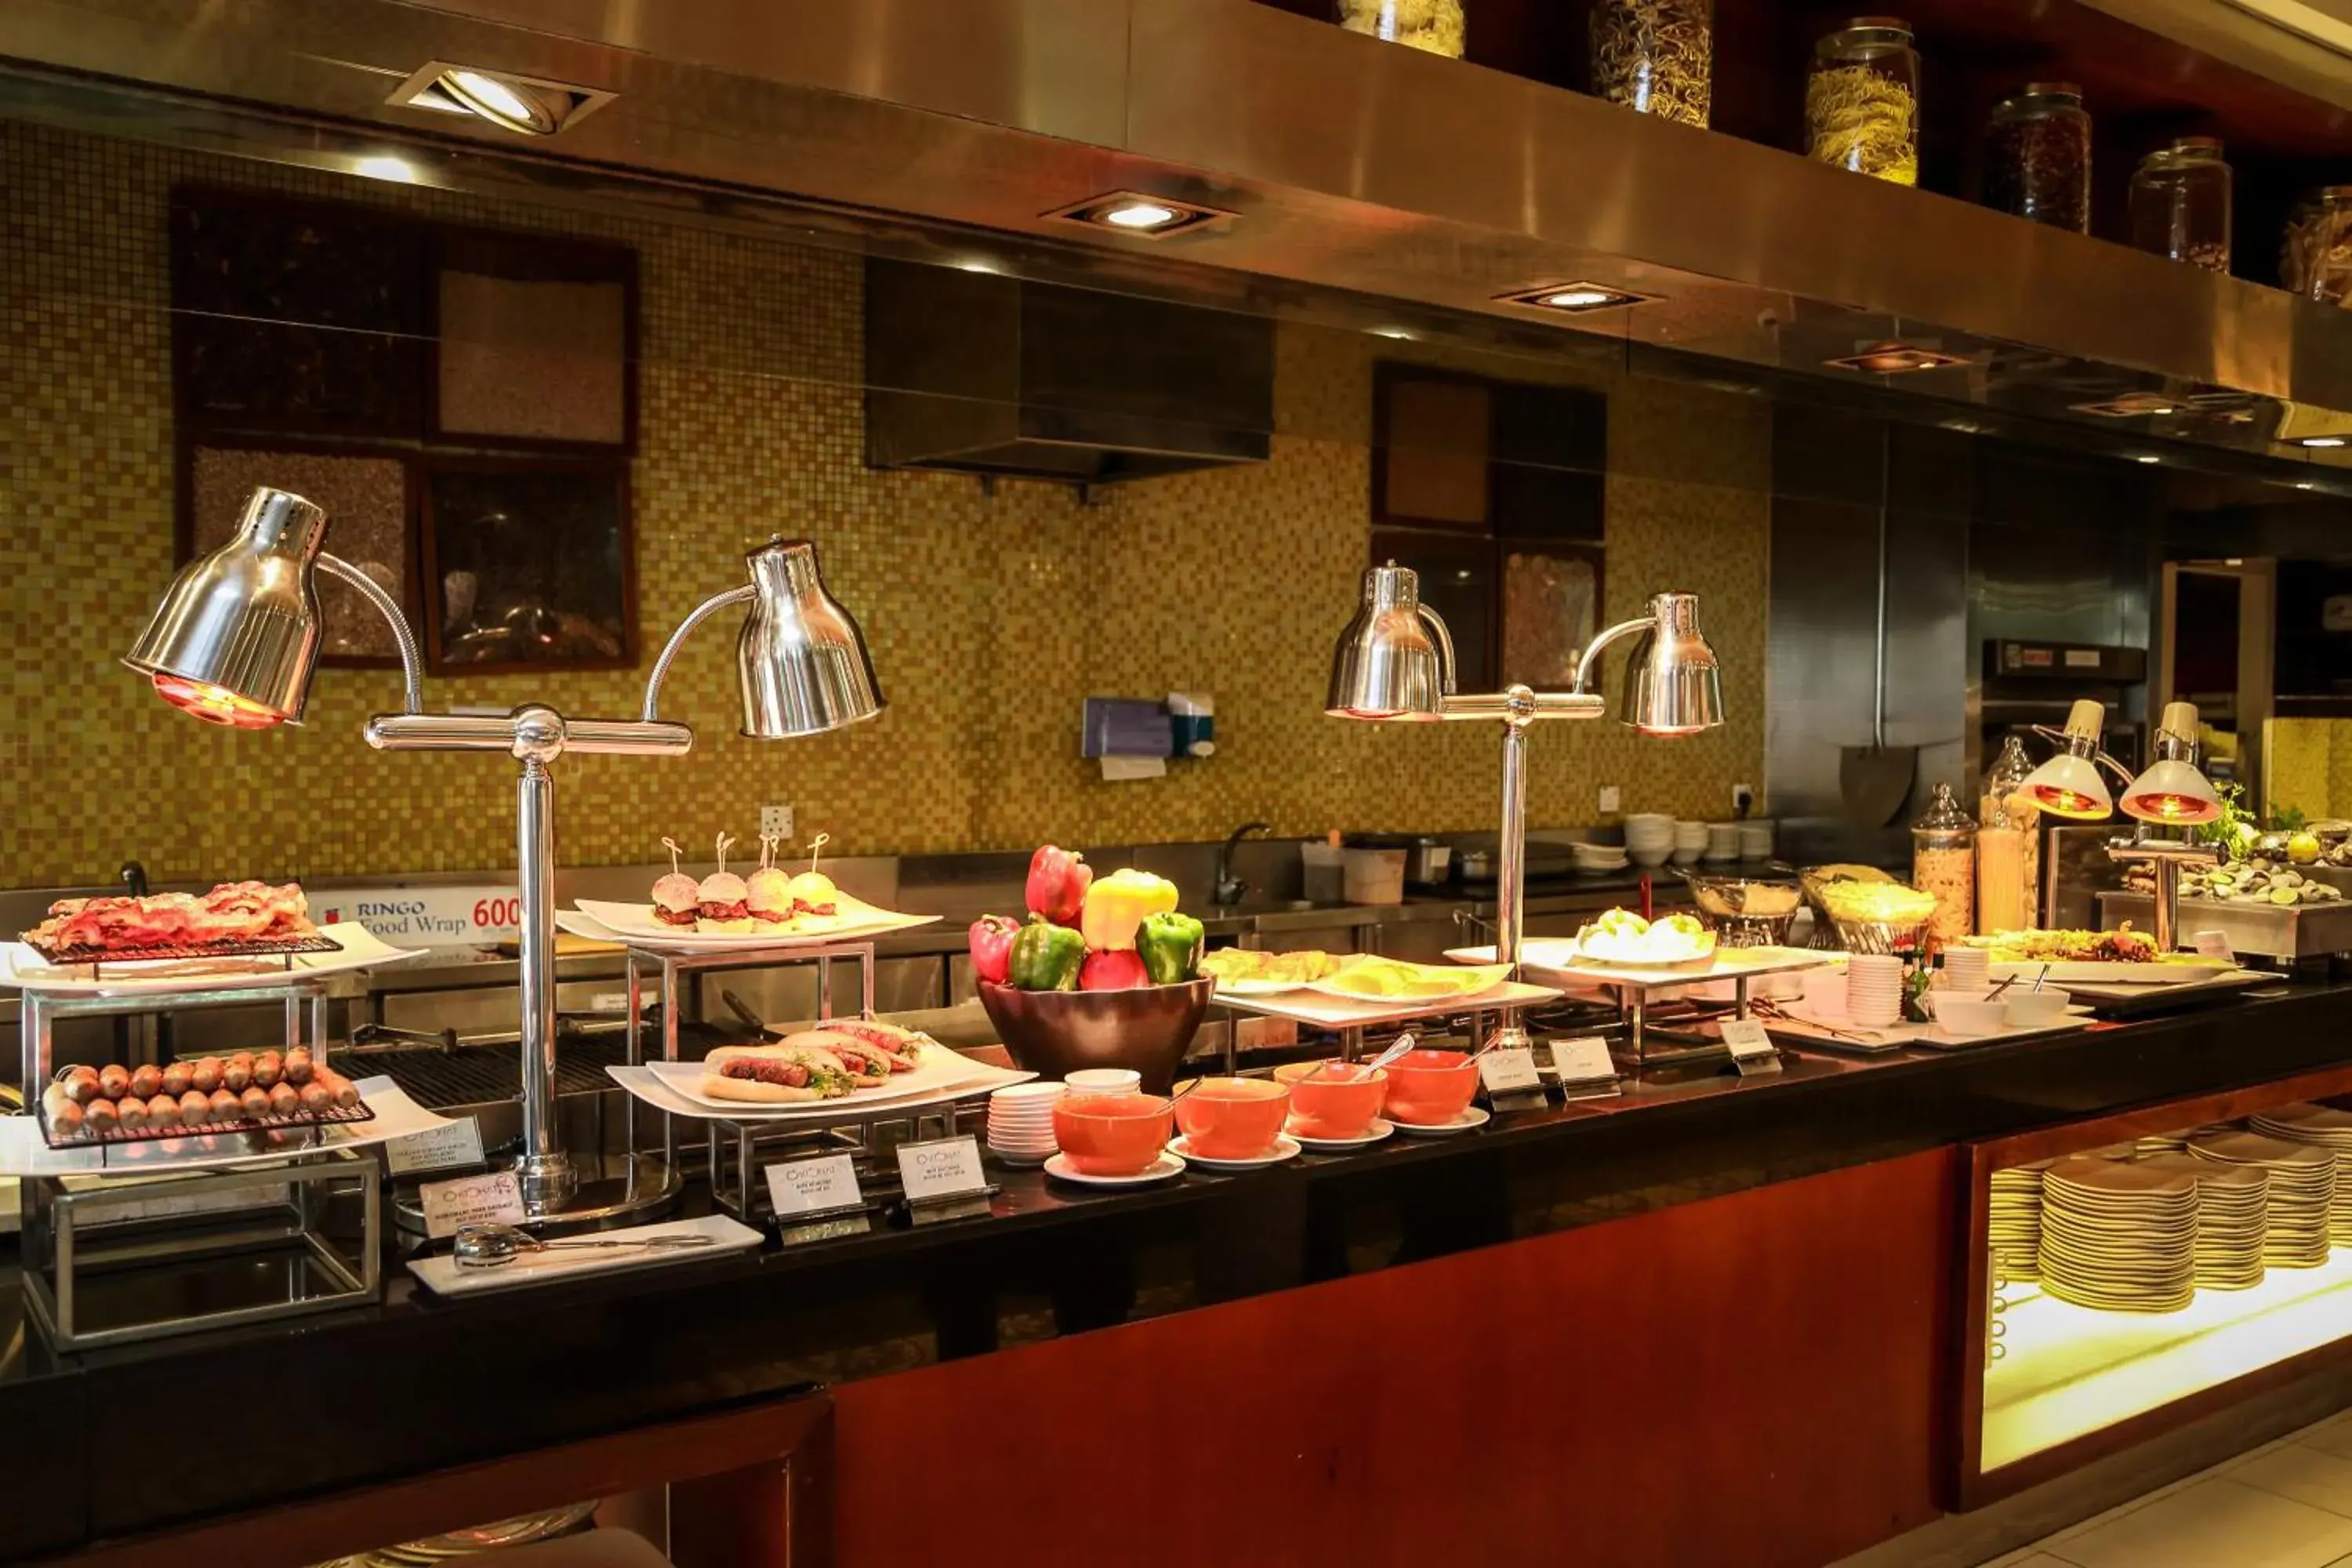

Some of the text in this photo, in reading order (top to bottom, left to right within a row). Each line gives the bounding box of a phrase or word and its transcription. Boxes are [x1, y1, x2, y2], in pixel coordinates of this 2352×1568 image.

[357, 901, 426, 916] RINGO
[473, 898, 520, 927] 600
[416, 916, 466, 935] Wrap
